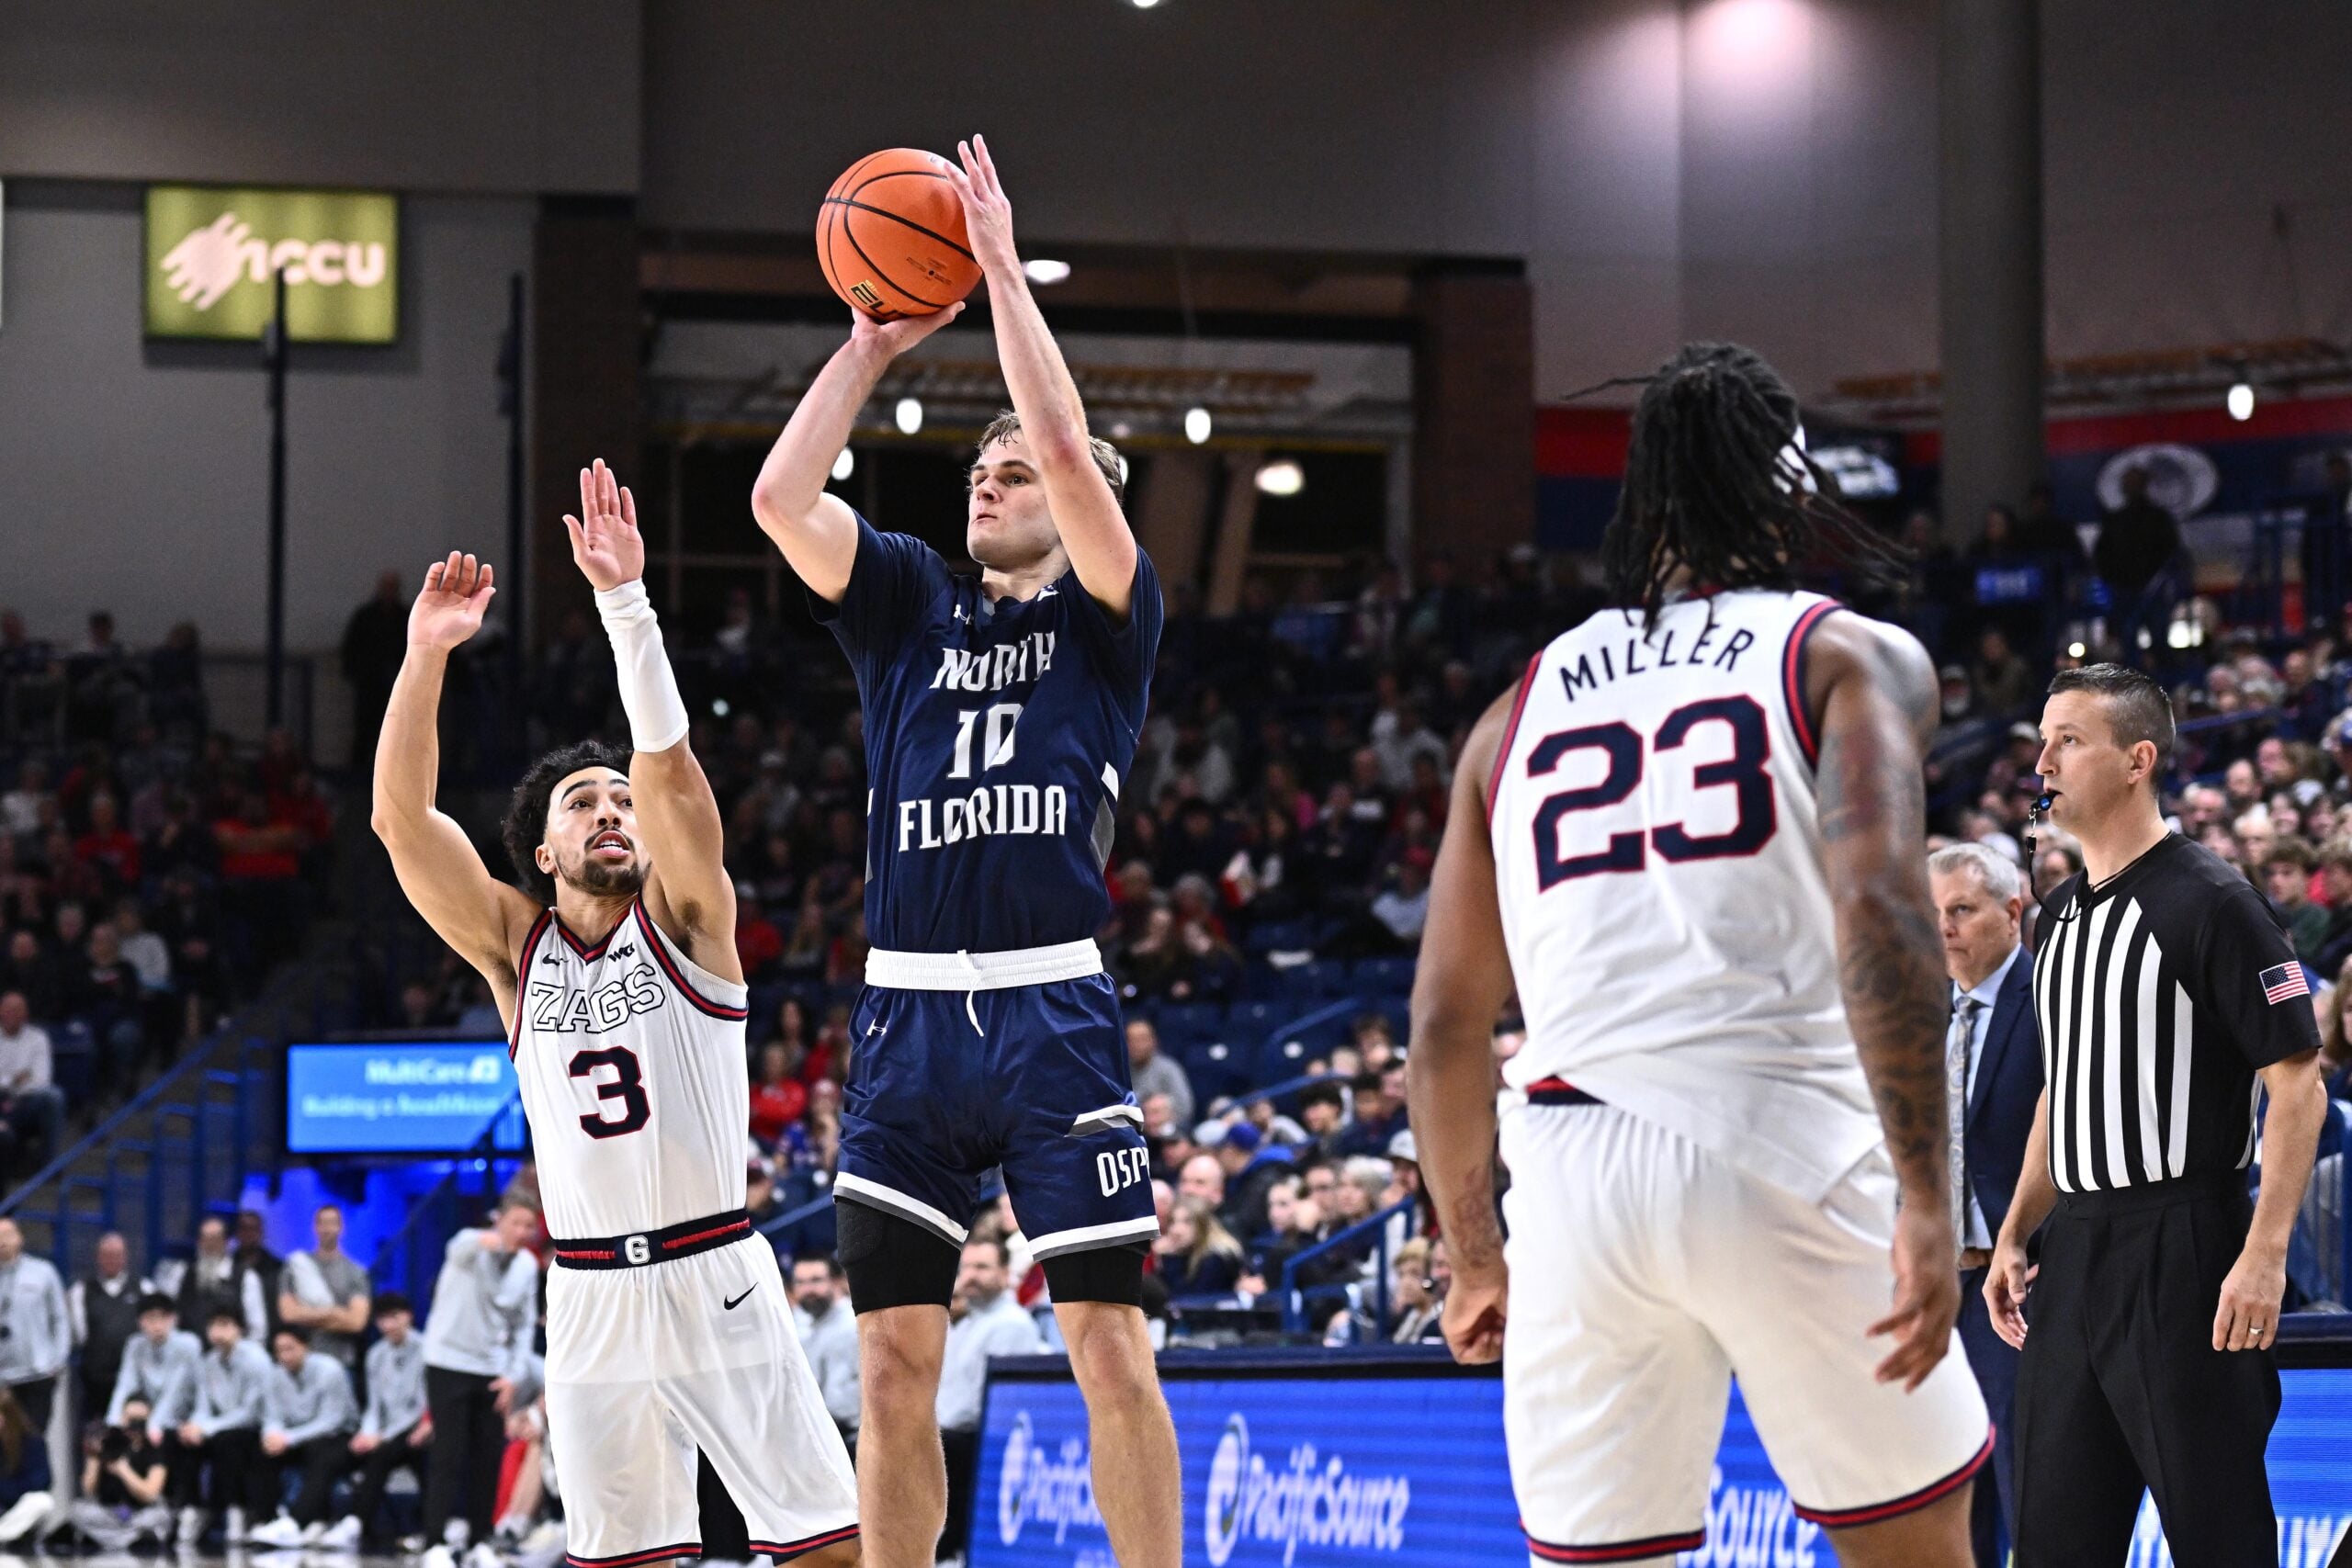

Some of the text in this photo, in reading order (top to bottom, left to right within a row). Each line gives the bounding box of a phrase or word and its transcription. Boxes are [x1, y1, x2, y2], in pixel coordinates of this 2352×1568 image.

[929, 631, 1056, 692] NORTH
[1559, 624, 1754, 702] MILLER
[946, 702, 1023, 779] 10
[898, 784, 1067, 852] FLORIDA
[1526, 694, 1778, 894] 23
[532, 963, 665, 1033] ZAGS
[569, 1045, 650, 1139] 3
[625, 1235, 650, 1264] G
[1240, 1442, 1408, 1567] PacificSource
